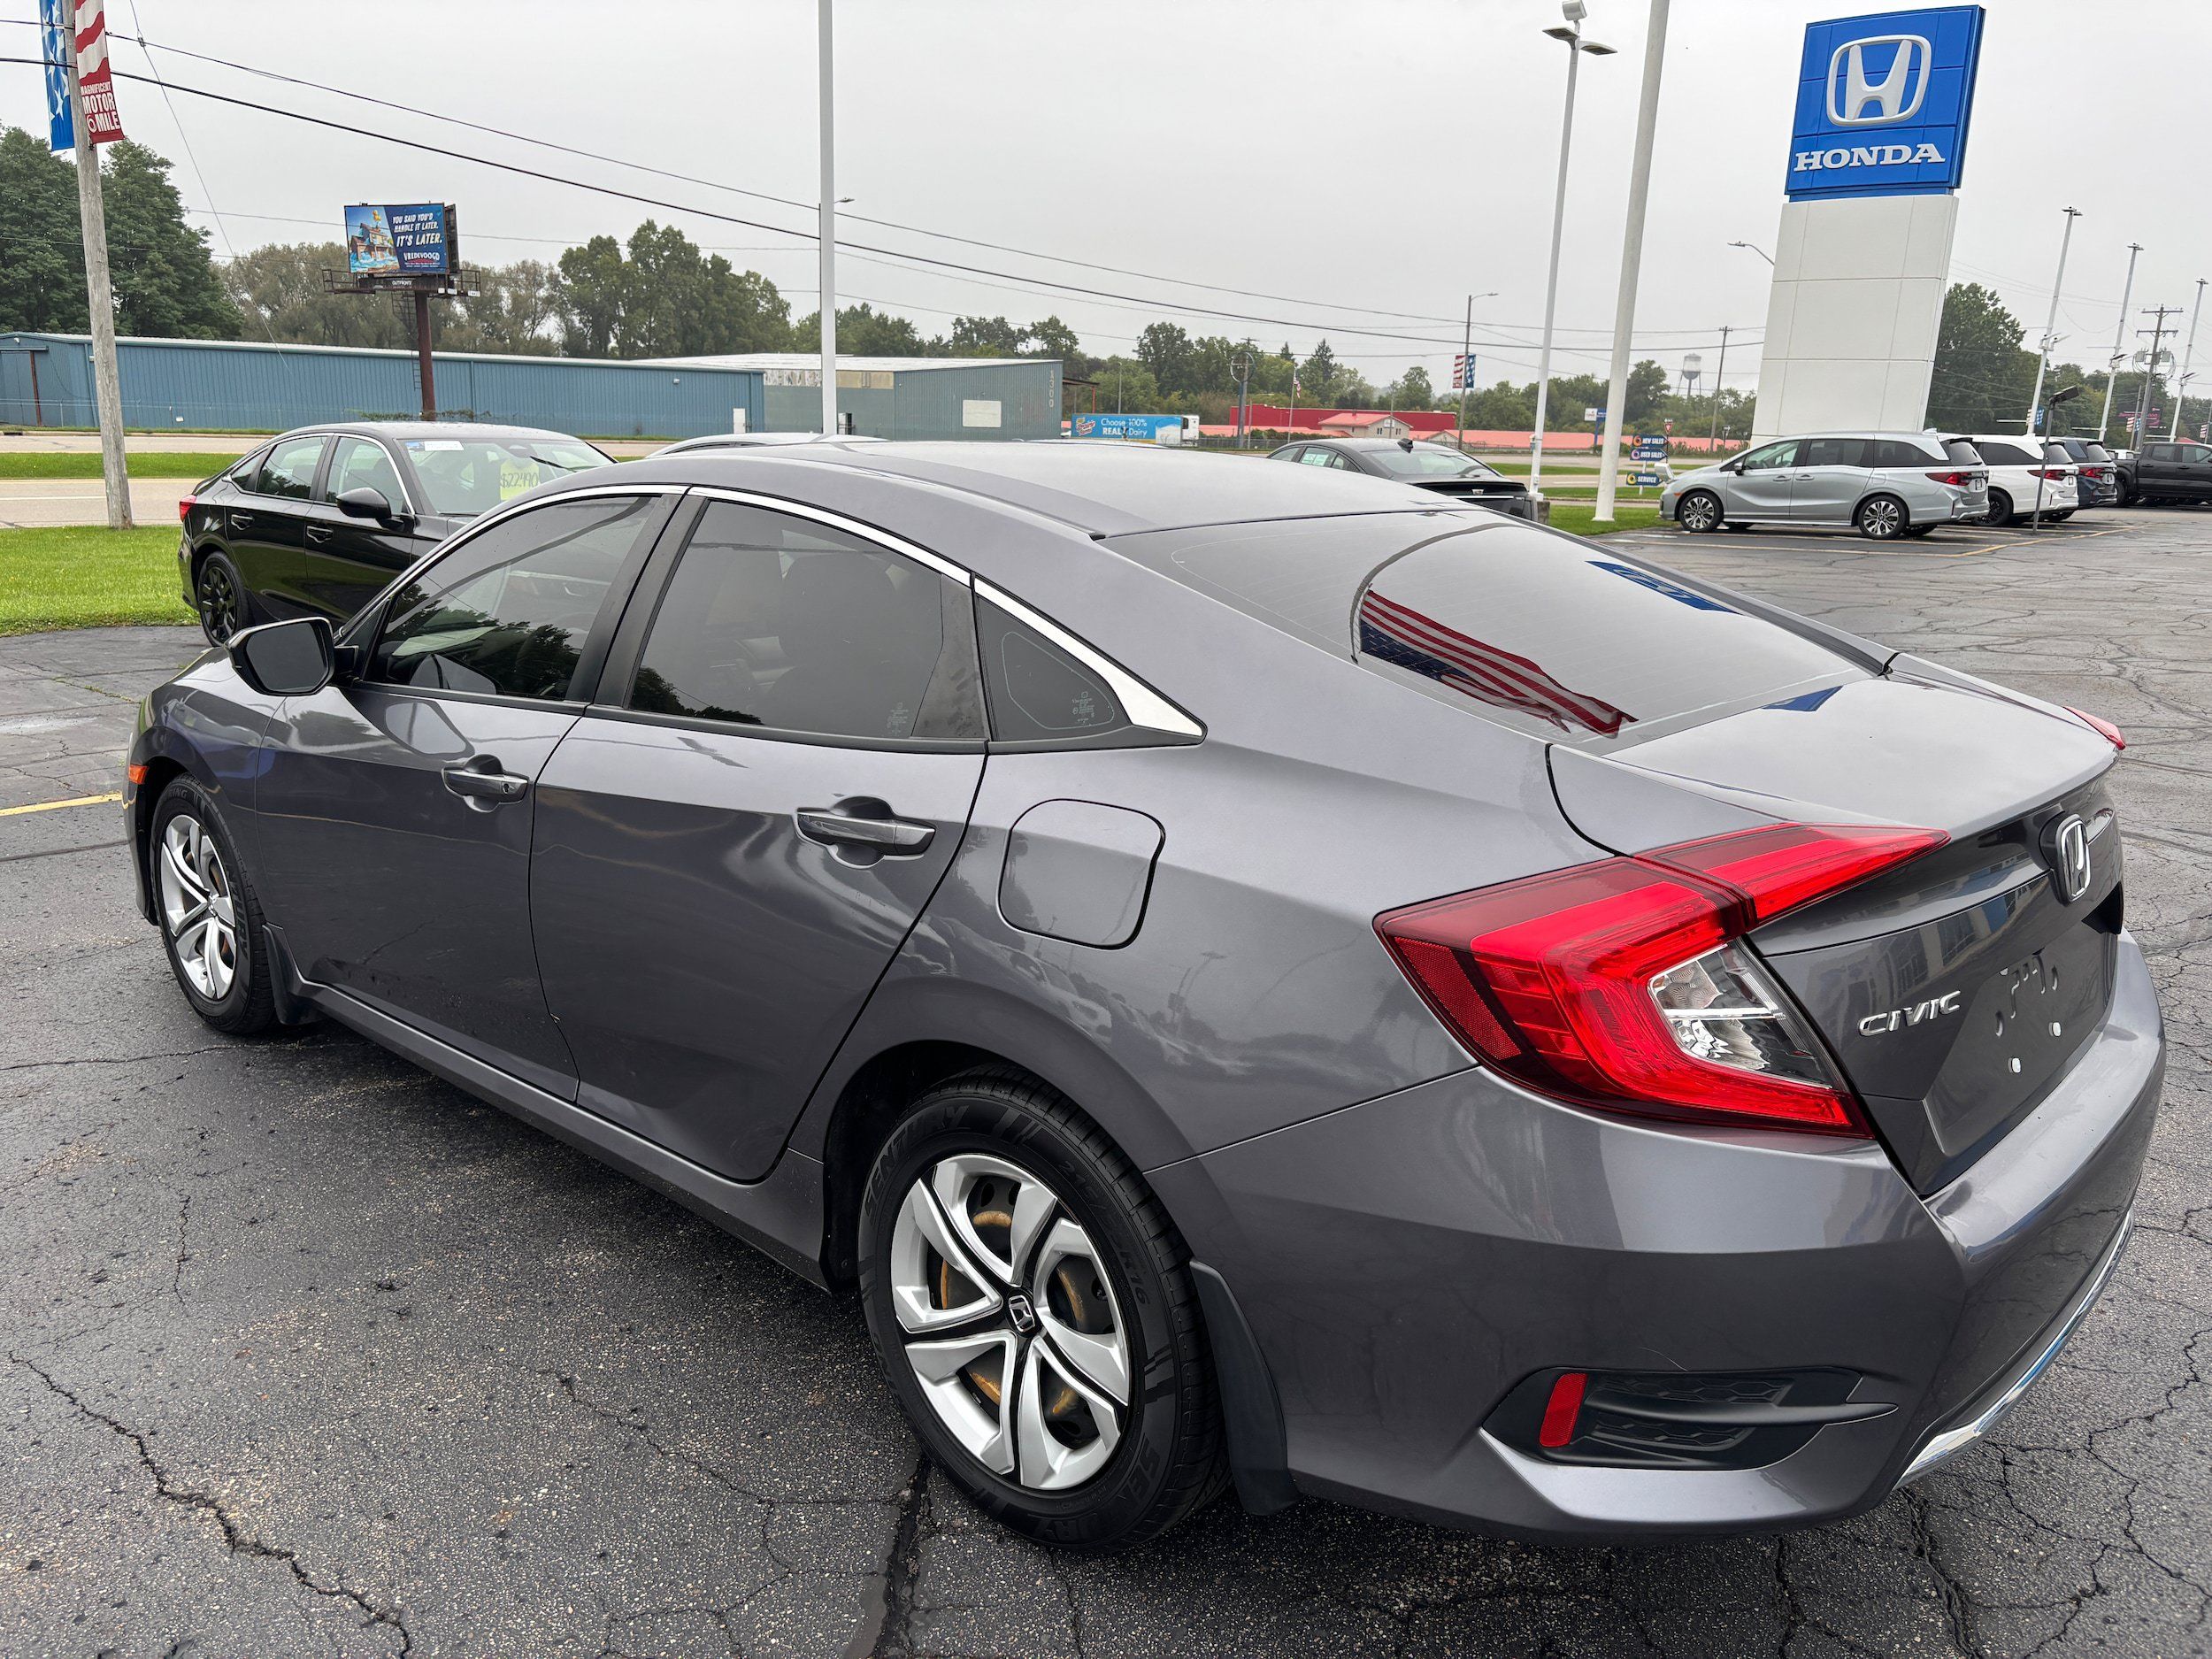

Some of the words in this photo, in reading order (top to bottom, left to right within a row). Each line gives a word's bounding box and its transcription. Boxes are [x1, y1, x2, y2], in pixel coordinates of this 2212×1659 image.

[80, 81, 111, 96] MAGNIFICENT
[81, 92, 116, 114] MOTOR
[95, 111, 120, 132] MILE
[1793, 143, 1945, 173] HONDA
[392, 215, 403, 224] YOU
[403, 214, 417, 223] SAID
[418, 212, 434, 221] YOU'D
[396, 234, 413, 248] IT'S
[416, 233, 443, 246] LATER.
[1101, 418, 1125, 426] Choose
[1128, 418, 1148, 426] 100%
[1129, 428, 1148, 438] Dairy
[1858, 990, 1961, 1036] CIVIC
